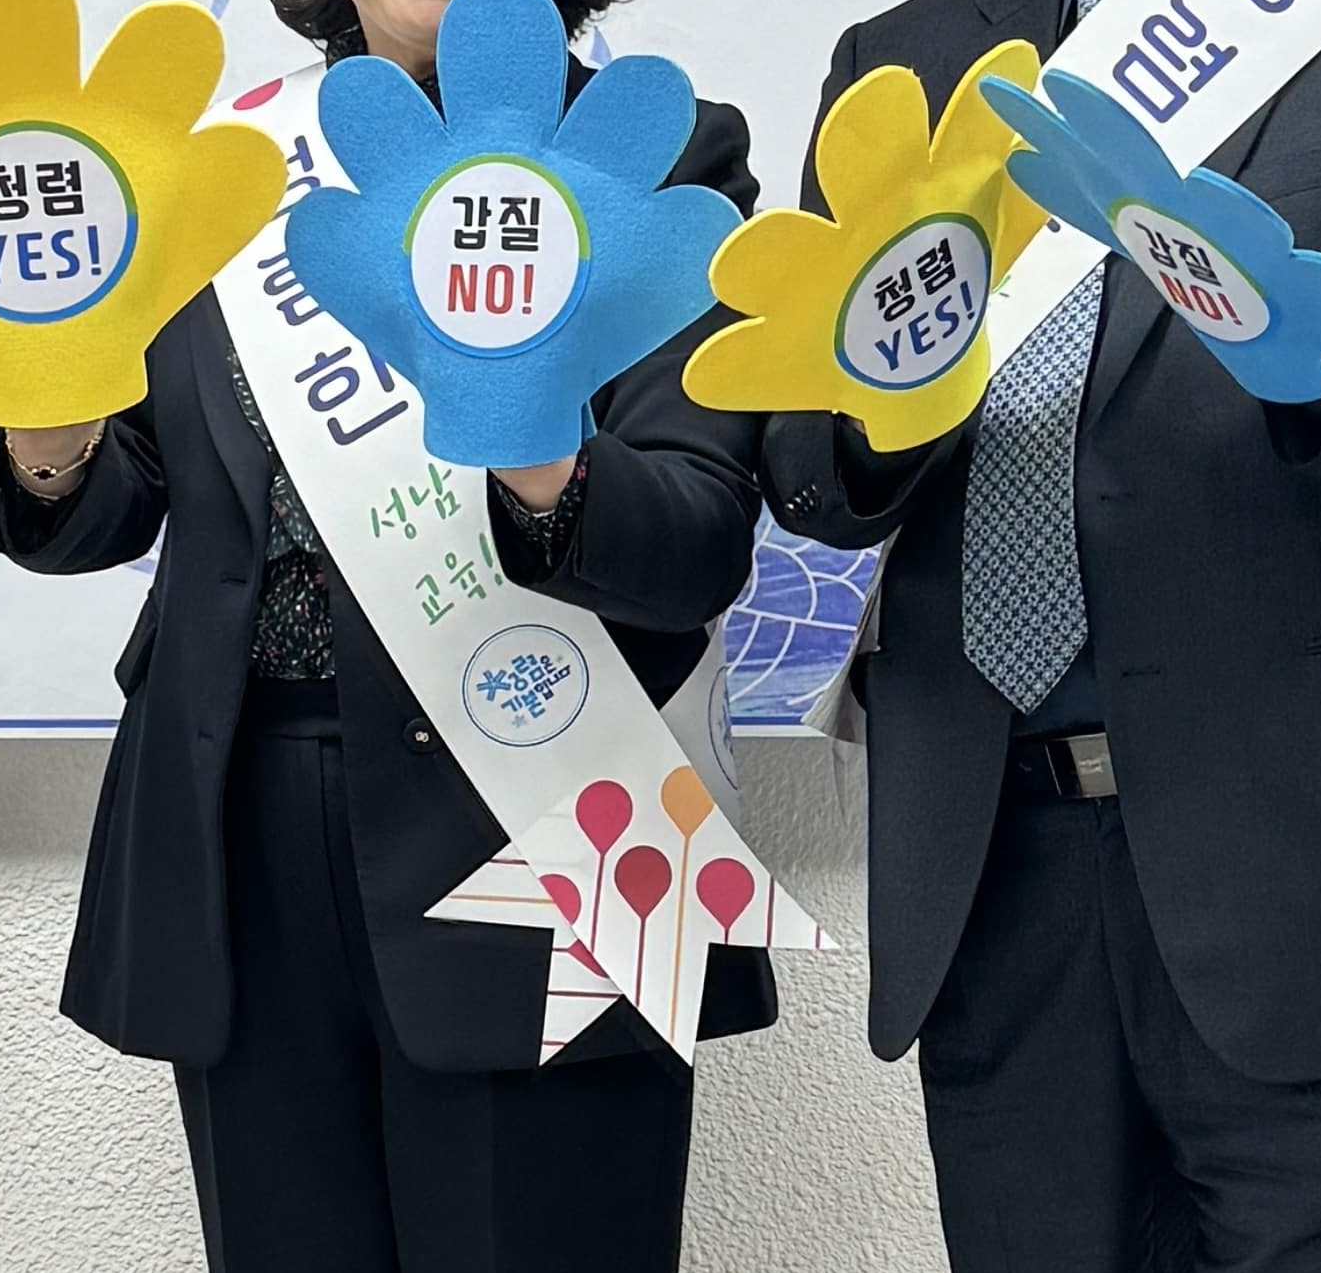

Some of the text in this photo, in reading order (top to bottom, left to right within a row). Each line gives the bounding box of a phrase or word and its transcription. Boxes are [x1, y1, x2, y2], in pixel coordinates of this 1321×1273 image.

[452, 195, 541, 253] 갑질
[1134, 221, 1223, 287] 갑질
[447, 263, 534, 316] NO!
[873, 237, 957, 323] 청렴
[1158, 269, 1244, 326] NO!
[874, 280, 976, 372] YES!
[370, 462, 462, 541] 성남
[416, 532, 503, 626] 교육!
